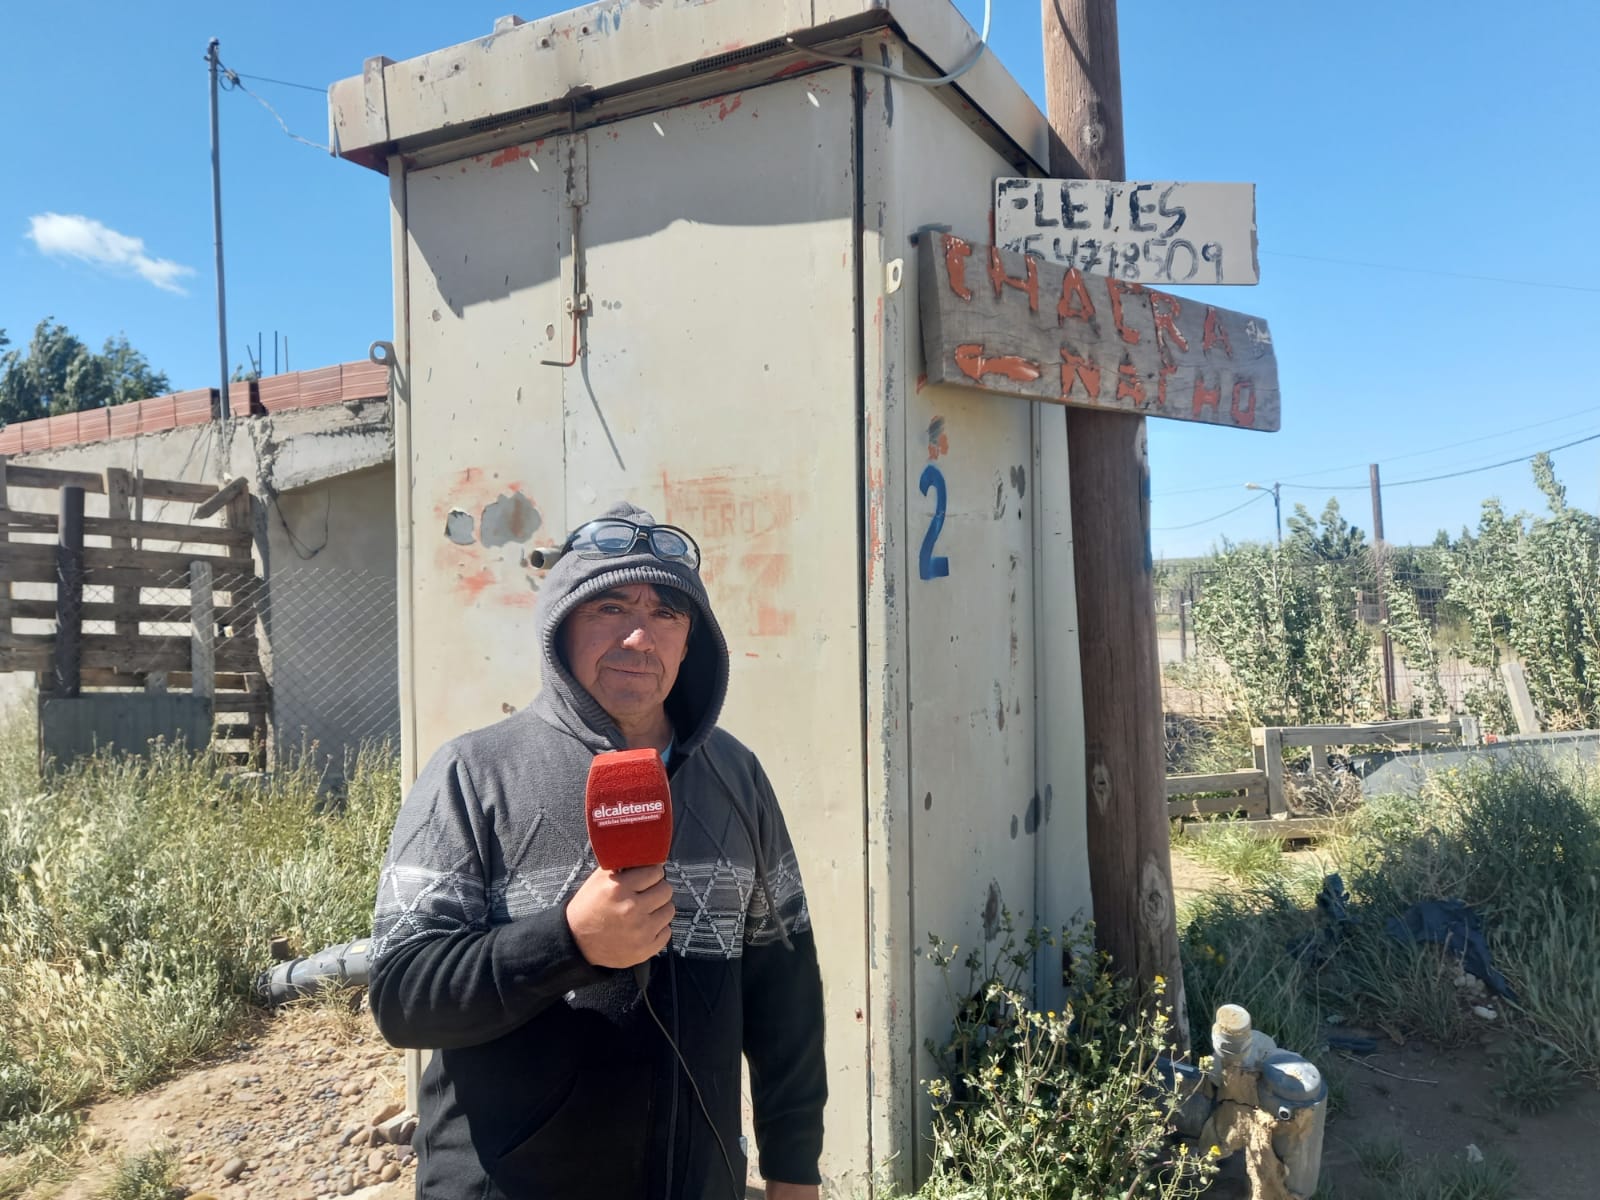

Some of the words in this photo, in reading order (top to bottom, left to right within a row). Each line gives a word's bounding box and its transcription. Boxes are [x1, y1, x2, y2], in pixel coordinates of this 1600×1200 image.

[998, 179, 1187, 238] FLETES
[942, 233, 1234, 360] CHACRA
[919, 464, 949, 580] 2
[594, 801, 663, 818] elcaletense
